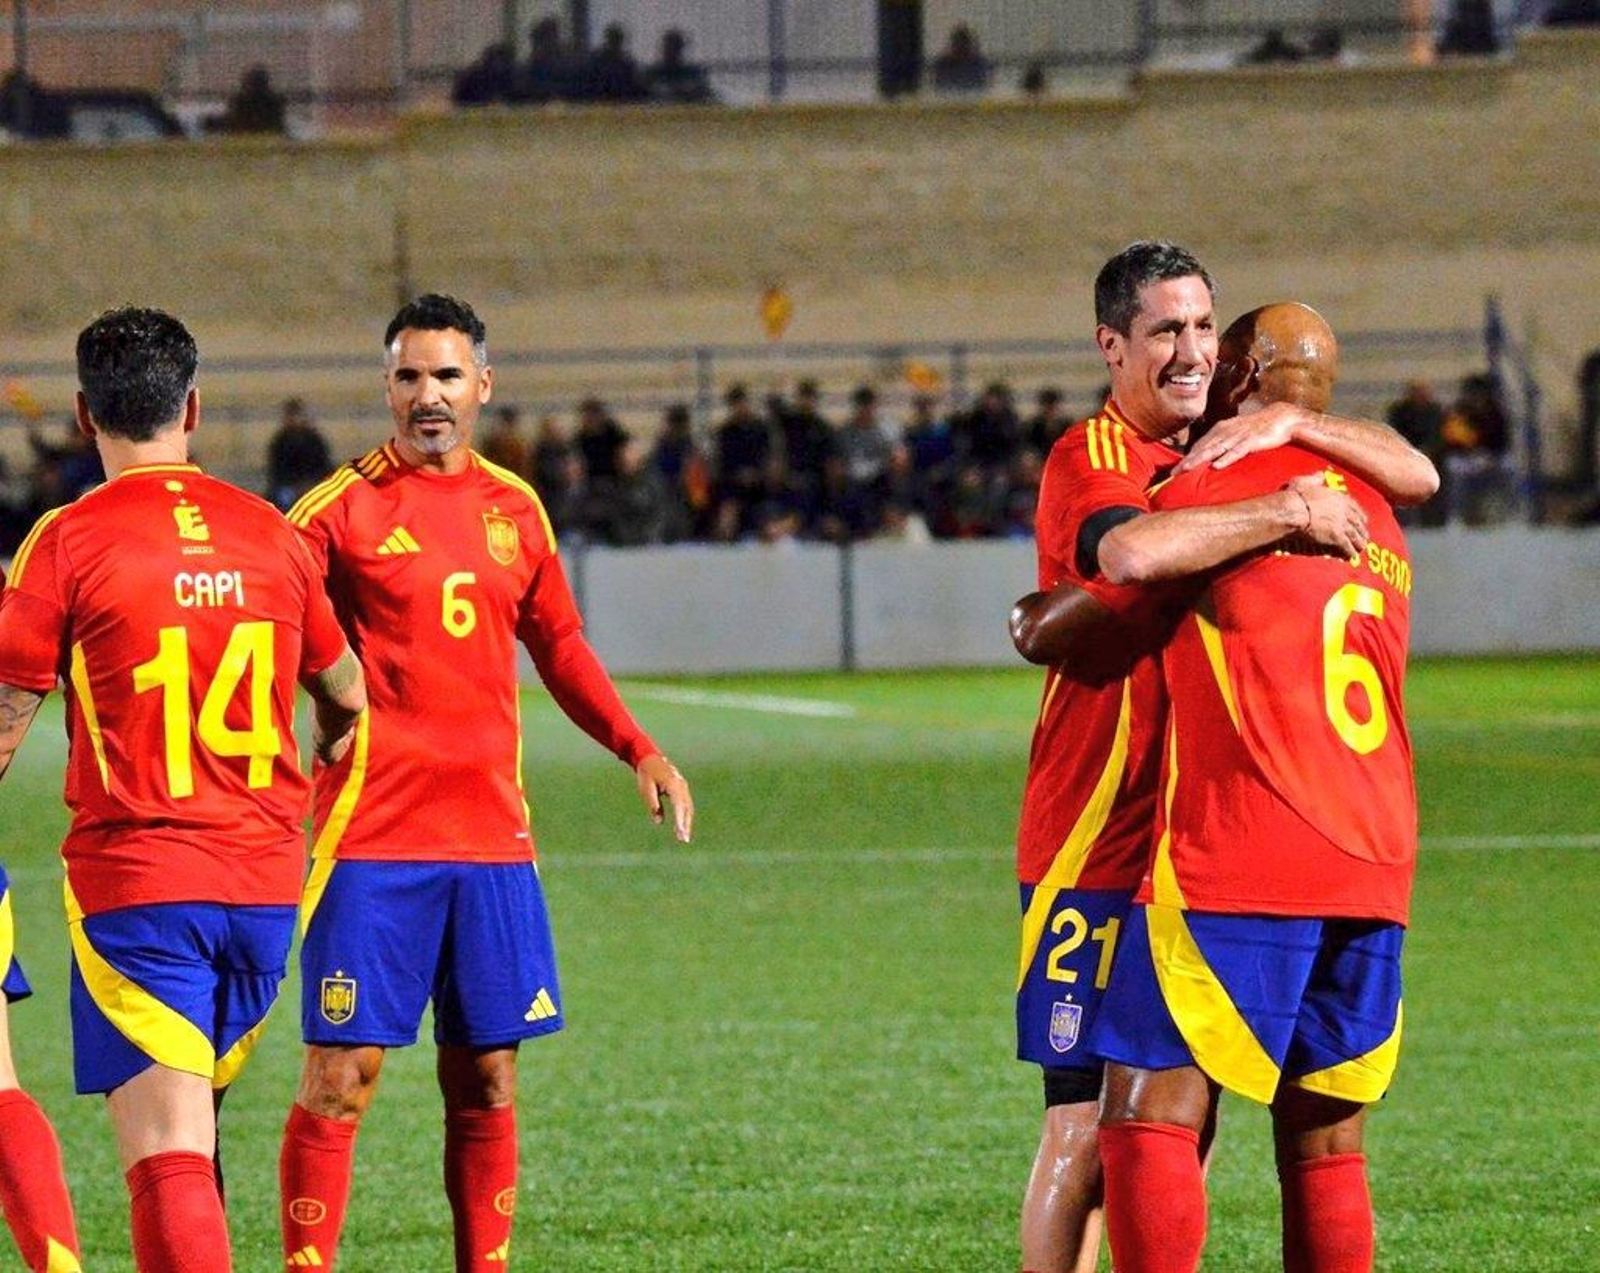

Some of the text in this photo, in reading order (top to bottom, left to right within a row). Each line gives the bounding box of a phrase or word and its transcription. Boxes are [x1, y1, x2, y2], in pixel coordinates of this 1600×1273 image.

[174, 570, 245, 607] CAPI
[442, 571, 476, 638] 6
[133, 621, 282, 798] 14
[1323, 583, 1388, 755] 6
[1046, 908, 1120, 989] 21
